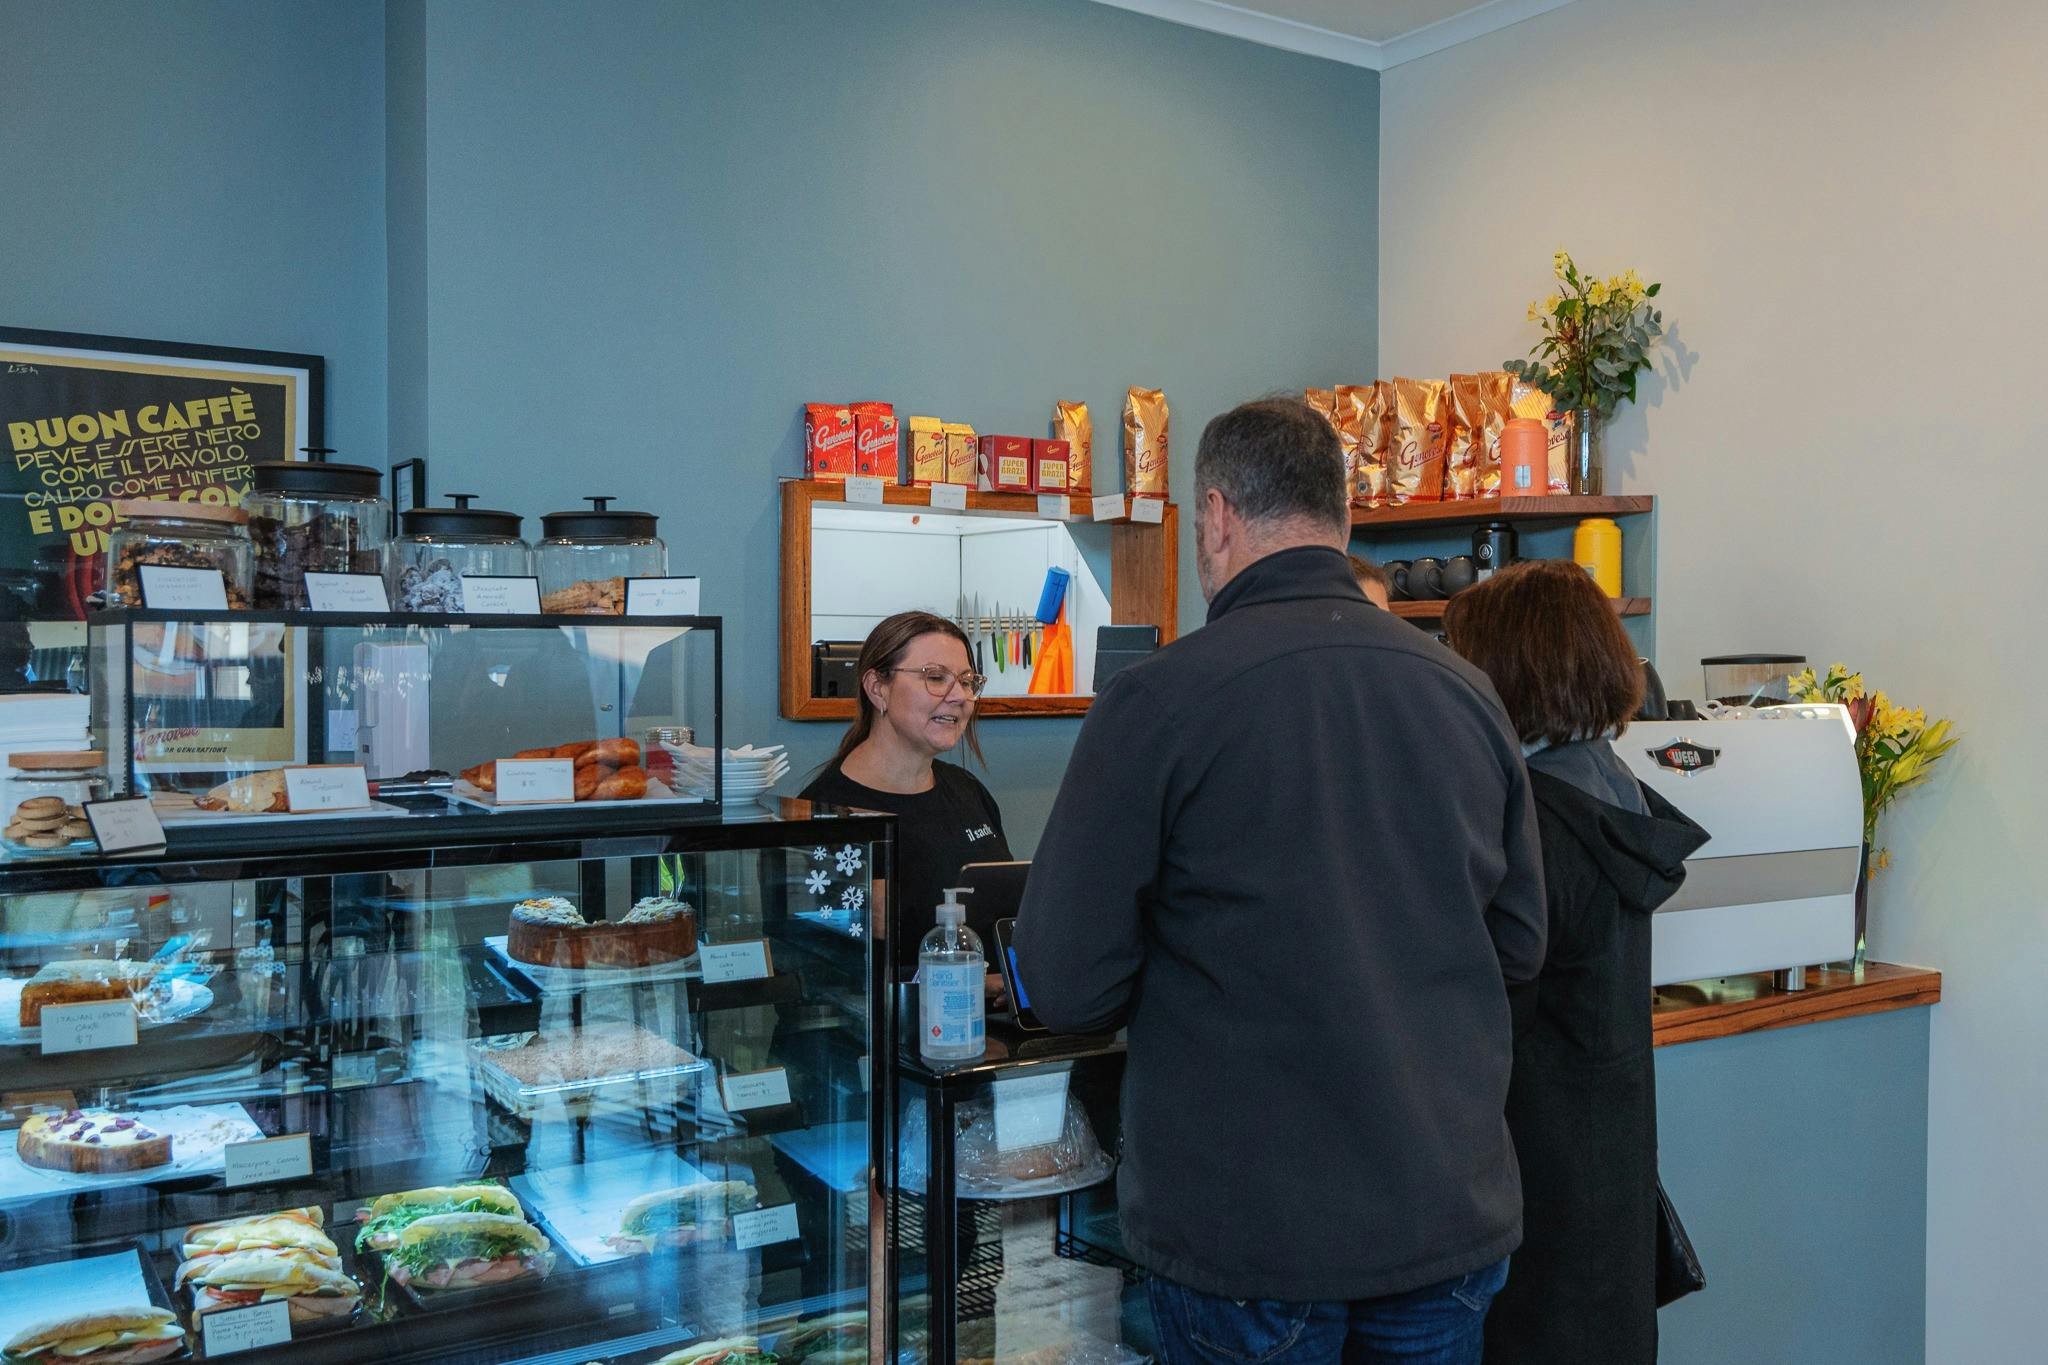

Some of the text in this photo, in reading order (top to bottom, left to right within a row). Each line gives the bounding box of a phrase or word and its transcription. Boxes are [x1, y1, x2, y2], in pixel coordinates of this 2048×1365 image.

[8, 387, 256, 451] BUON CAFFÈ
[16, 423, 260, 472] DEVE ESSERE NERO
[916, 446, 944, 464] Genoves
[41, 444, 248, 487] COME IL DIAVOLO,
[949, 448, 976, 468] Genoves
[1003, 459, 1025, 467] SUPER
[1001, 467, 1025, 475] BRAZIL
[24, 464, 256, 507] CALDO COME L'INFER
[29, 481, 255, 535] E DOL COM
[177, 746, 228, 754] GENERATIONS
[1671, 750, 1702, 766] WEGA
[56, 1013, 93, 1024] ITALIAN
